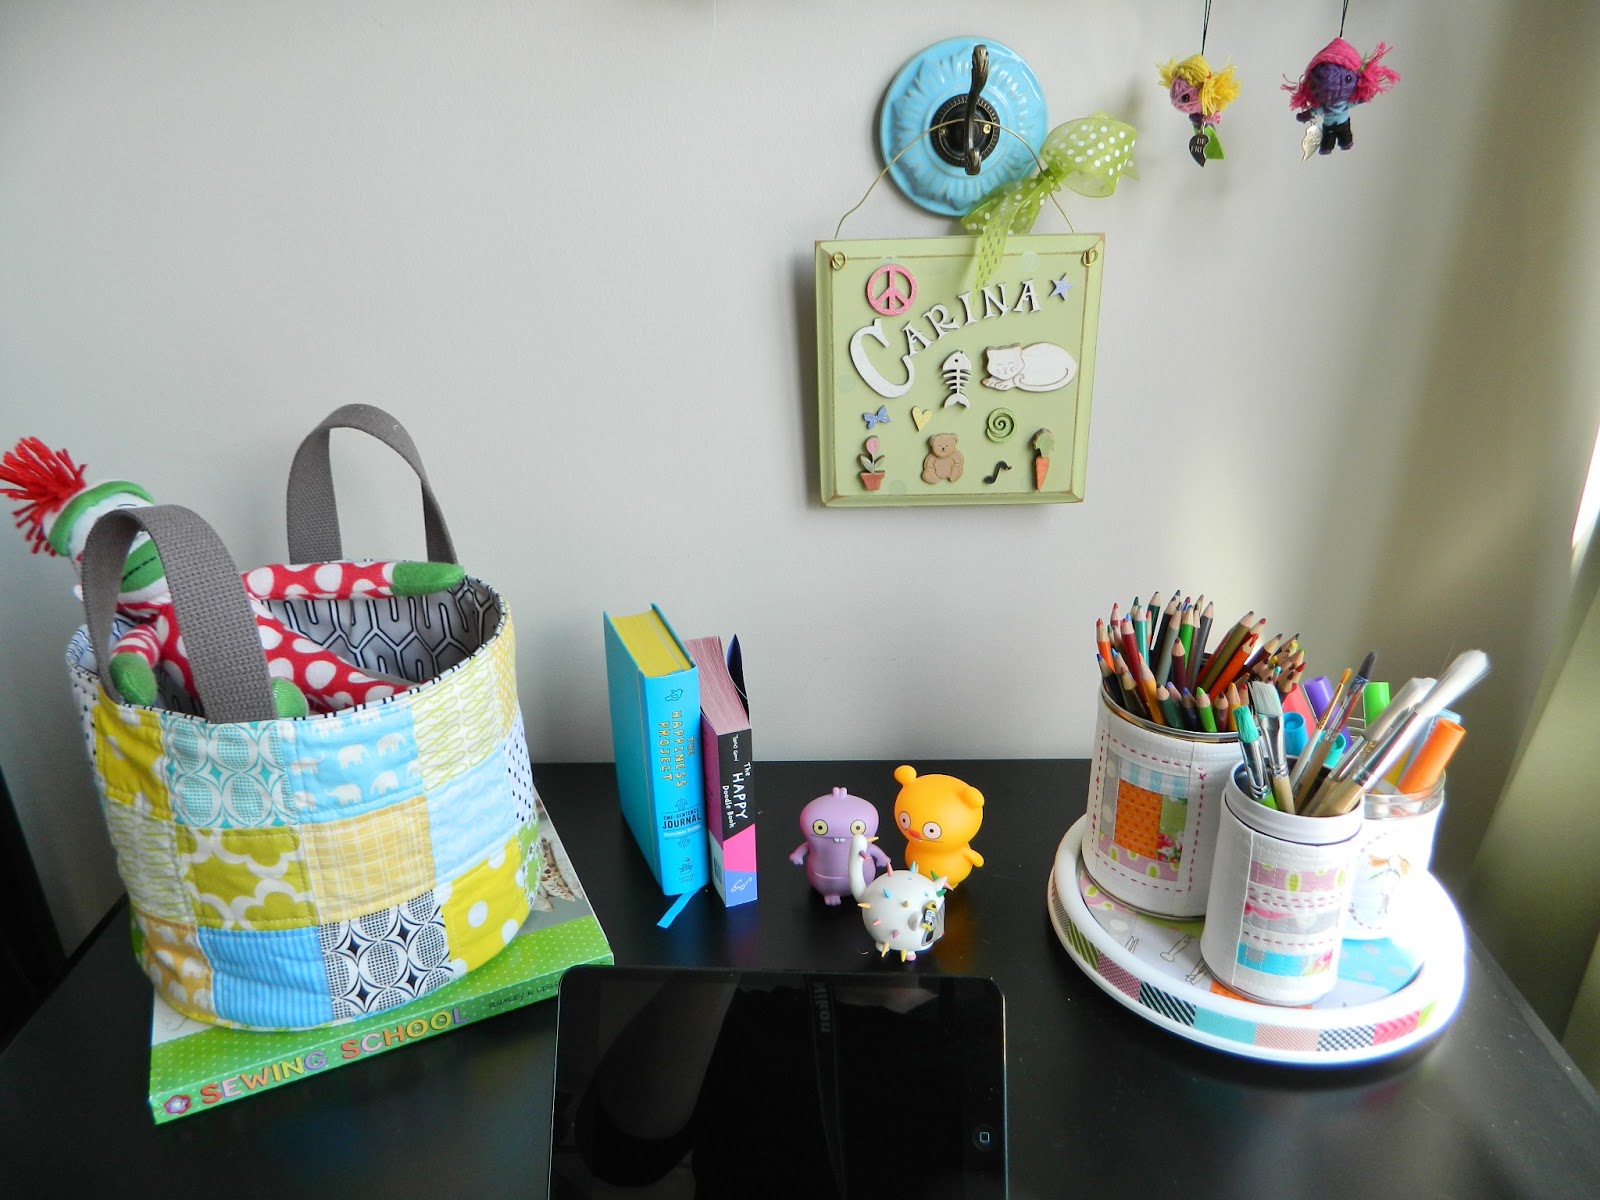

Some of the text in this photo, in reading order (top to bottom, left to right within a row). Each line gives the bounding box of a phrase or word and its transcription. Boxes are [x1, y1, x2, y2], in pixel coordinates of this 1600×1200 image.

[849, 278, 1043, 398] CARINA
[658, 721, 673, 781] PROJECT
[672, 710, 687, 787] HAPPINESS
[687, 736, 695, 756] THE
[743, 762, 752, 776] The
[722, 785, 736, 829] Doodle Book
[732, 772, 748, 819] HAPPY
[662, 813, 701, 829] JOURNAL
[200, 1007, 470, 1104] SEWING SCHOOL
